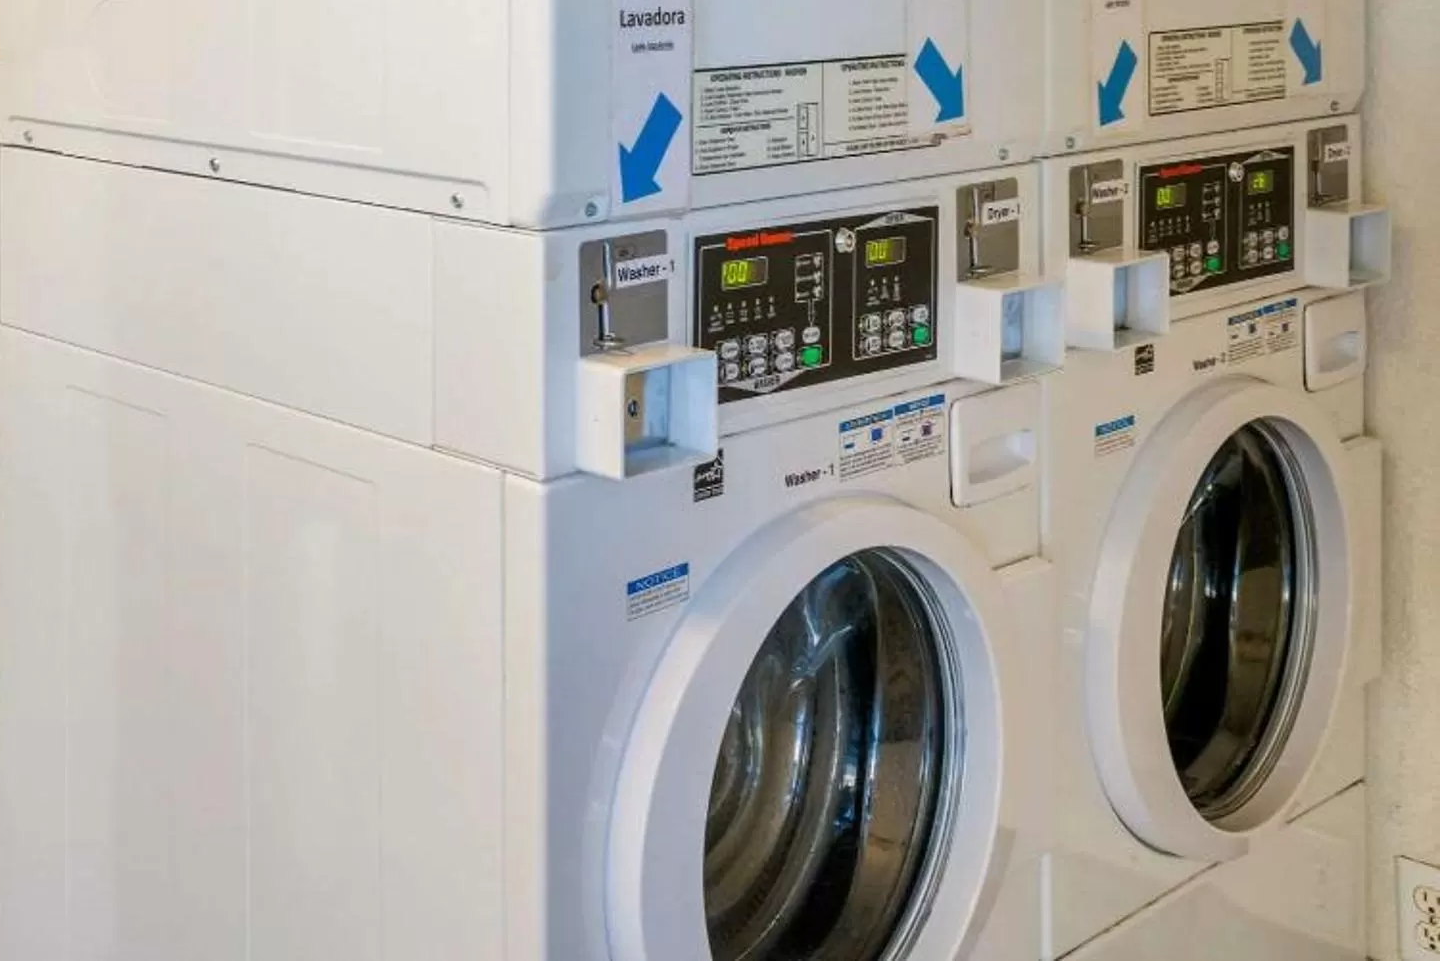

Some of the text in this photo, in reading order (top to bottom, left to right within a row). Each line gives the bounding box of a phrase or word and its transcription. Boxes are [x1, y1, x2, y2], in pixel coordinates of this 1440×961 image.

[619, 6, 685, 28] Lavadora
[617, 263, 660, 282] Washer
[784, 468, 821, 488] Washer
